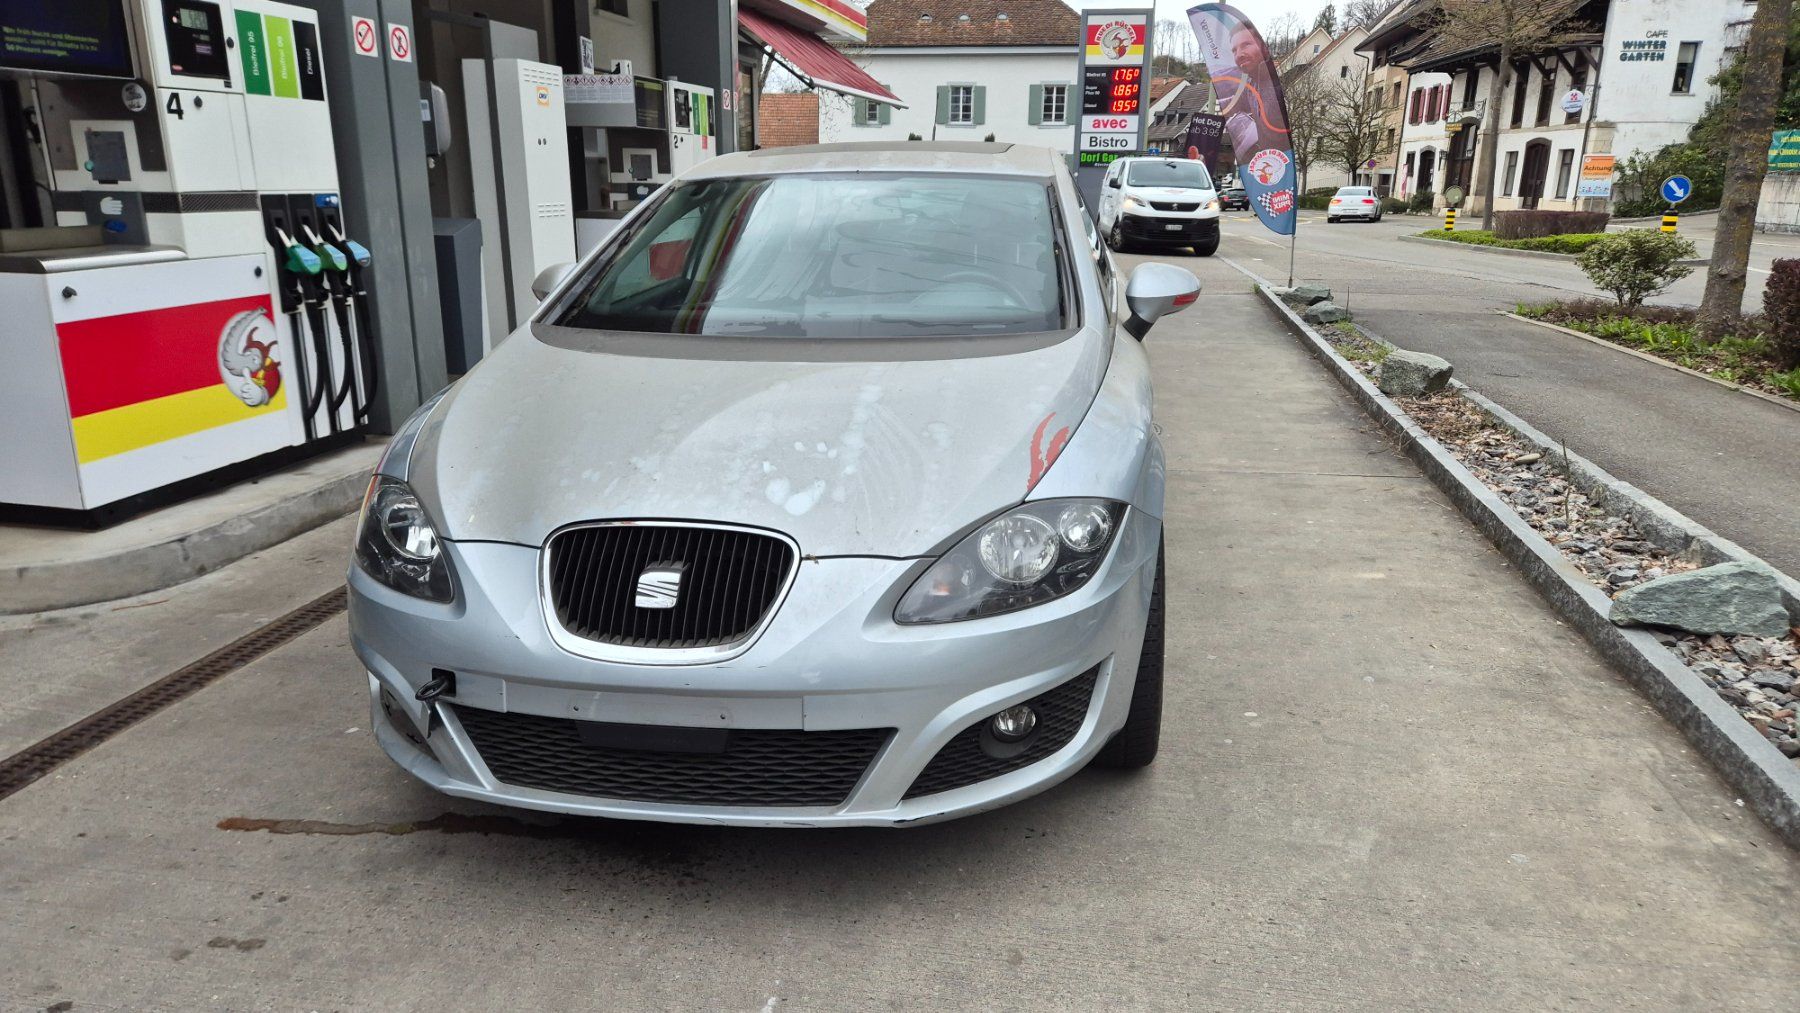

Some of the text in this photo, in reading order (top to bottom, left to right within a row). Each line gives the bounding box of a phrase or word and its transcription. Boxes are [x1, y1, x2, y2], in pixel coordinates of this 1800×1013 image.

[1096, 20, 1136, 41] RUEDI RÜSSEL
[248, 30, 256, 43] 95
[1622, 40, 1666, 49] WINTER
[305, 47, 314, 75] Diesel
[1620, 52, 1664, 61] GARTEN
[167, 92, 184, 120] 4
[1092, 119, 1127, 128] avec
[1192, 116, 1221, 128] Hot Dog
[1202, 126, 1220, 137] 3.95
[673, 135, 679, 148] 2
[1089, 136, 1128, 147] Bistro
[1081, 152, 1120, 162] Dorf Gar
